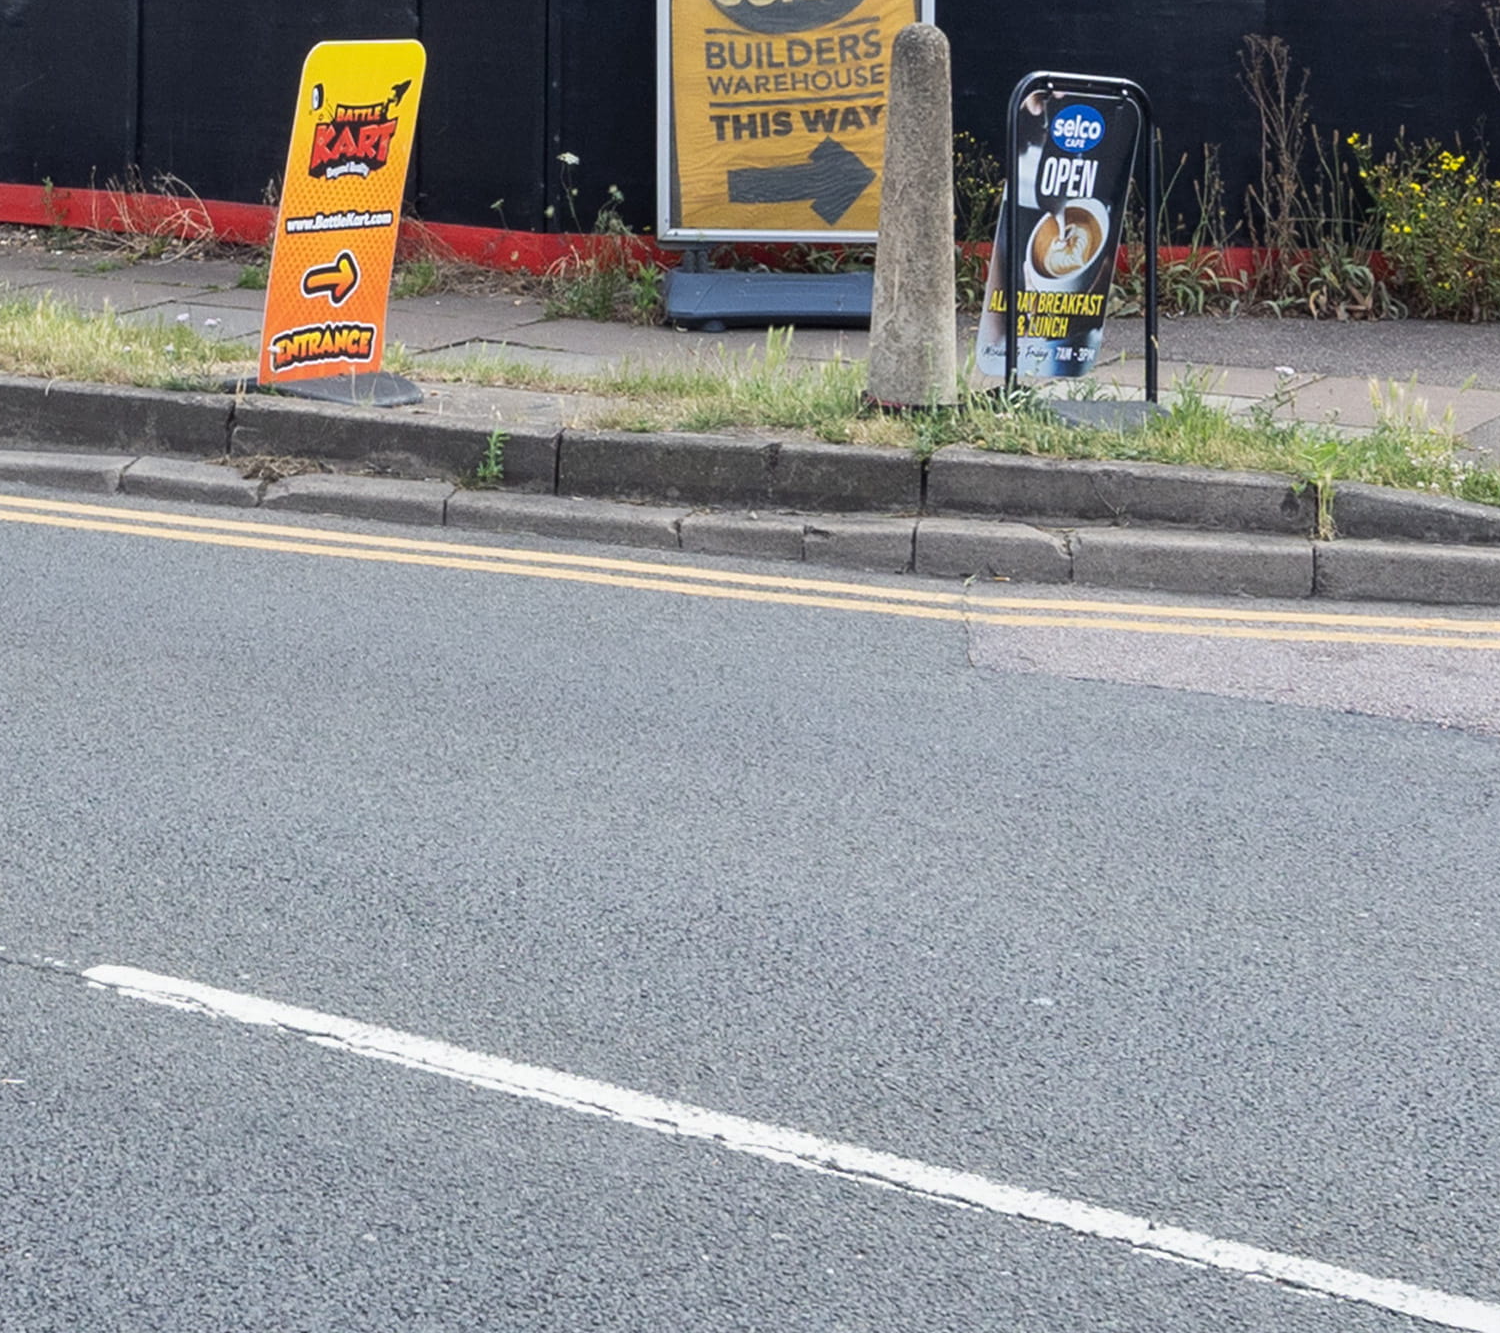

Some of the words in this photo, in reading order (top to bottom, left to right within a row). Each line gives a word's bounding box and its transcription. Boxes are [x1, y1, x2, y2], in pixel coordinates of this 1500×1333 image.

[705, 29, 883, 71] BUILDERS
[707, 64, 886, 96] WAREHOUSE
[336, 106, 381, 121] BATTLE
[709, 111, 794, 142] THIS
[801, 104, 888, 133] WAY
[1053, 114, 1102, 140] selco
[311, 119, 397, 170] KART
[1041, 156, 1098, 198] OPEN
[1037, 292, 1105, 316] BREAKFAST
[1028, 316, 1069, 337] LUNCH
[276, 329, 372, 364] ENTRANCE
